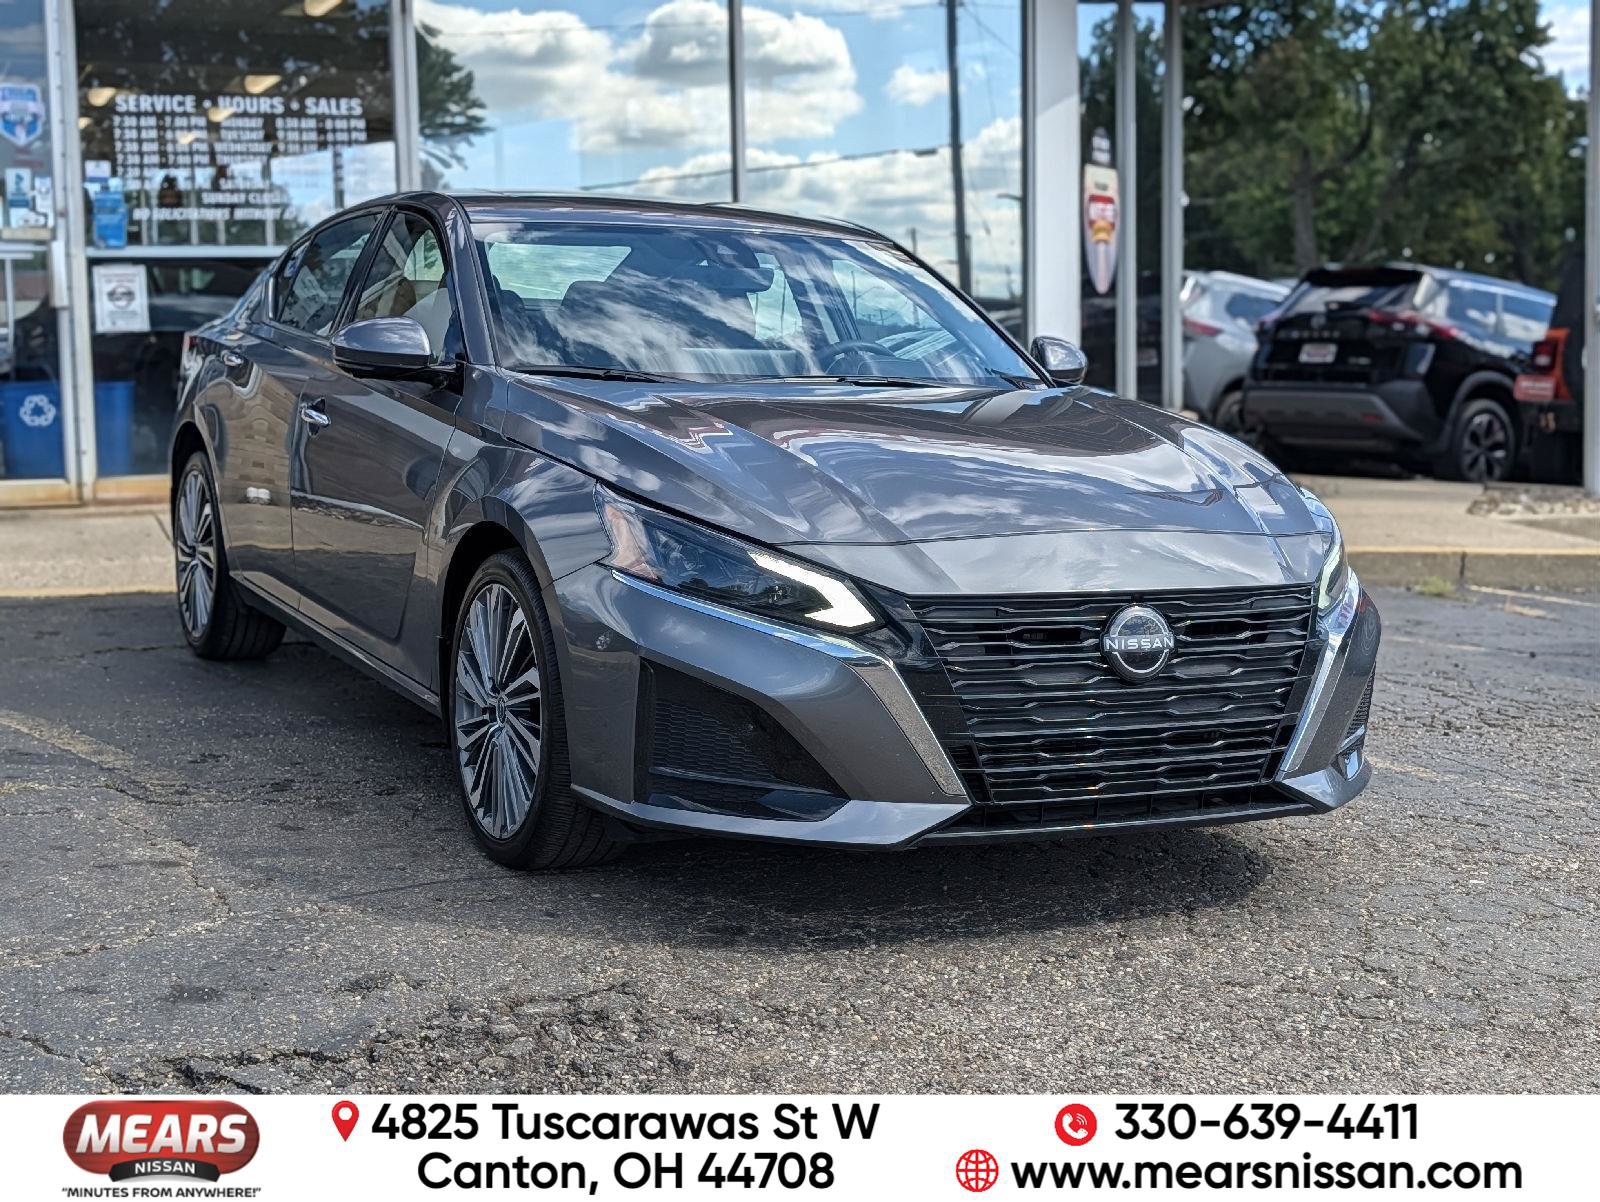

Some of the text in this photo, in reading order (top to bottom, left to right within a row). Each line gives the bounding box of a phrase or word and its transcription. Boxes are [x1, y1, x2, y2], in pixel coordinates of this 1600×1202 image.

[115, 95, 363, 116] SERVICE HOURS SALES
[1105, 636, 1175, 650] NISSAN
